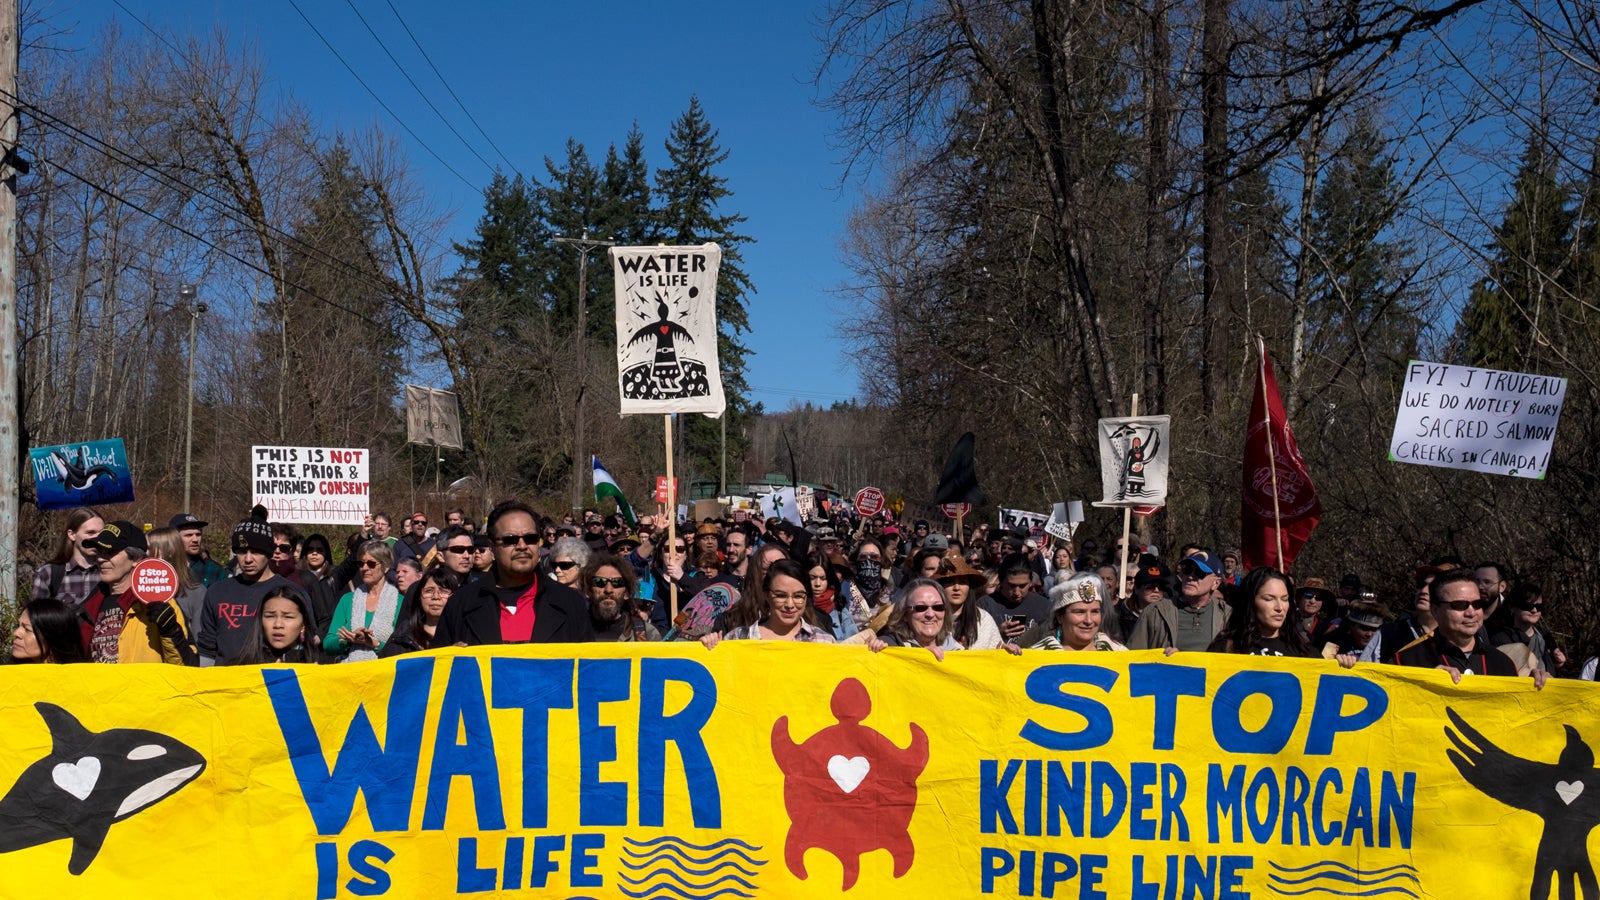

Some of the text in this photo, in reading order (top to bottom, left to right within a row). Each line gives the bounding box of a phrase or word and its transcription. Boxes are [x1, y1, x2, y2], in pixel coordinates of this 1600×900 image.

[618, 254, 706, 274] WATER
[639, 275, 688, 287] IS LIFE
[1409, 364, 1561, 396] FYI J TRUDEAU
[1405, 391, 1430, 408] WE
[1439, 393, 1459, 409] DO
[1528, 402, 1558, 416] BURY
[1416, 415, 1554, 441] SACRED SALMON
[255, 448, 363, 464] THIS IS NOT
[1396, 441, 1455, 464] CREEKS
[1461, 451, 1477, 463] IN
[32, 455, 57, 482] Will
[302, 463, 343, 479] PRIOR
[349, 465, 359, 479] &
[256, 480, 369, 496] INFORMED CONSENT
[863, 491, 881, 500] STOP
[313, 498, 367, 521] MORGAN
[138, 576, 169, 585] Kinder
[139, 568, 168, 578] #Stop
[137, 584, 172, 594] Morgan
[1018, 662, 1389, 755] STOP
[260, 656, 722, 835] WATER
[980, 758, 1417, 850] KINDER MORGAN
[314, 833, 606, 900] IS LIFE
[980, 847, 1254, 900] PIPE LINE
